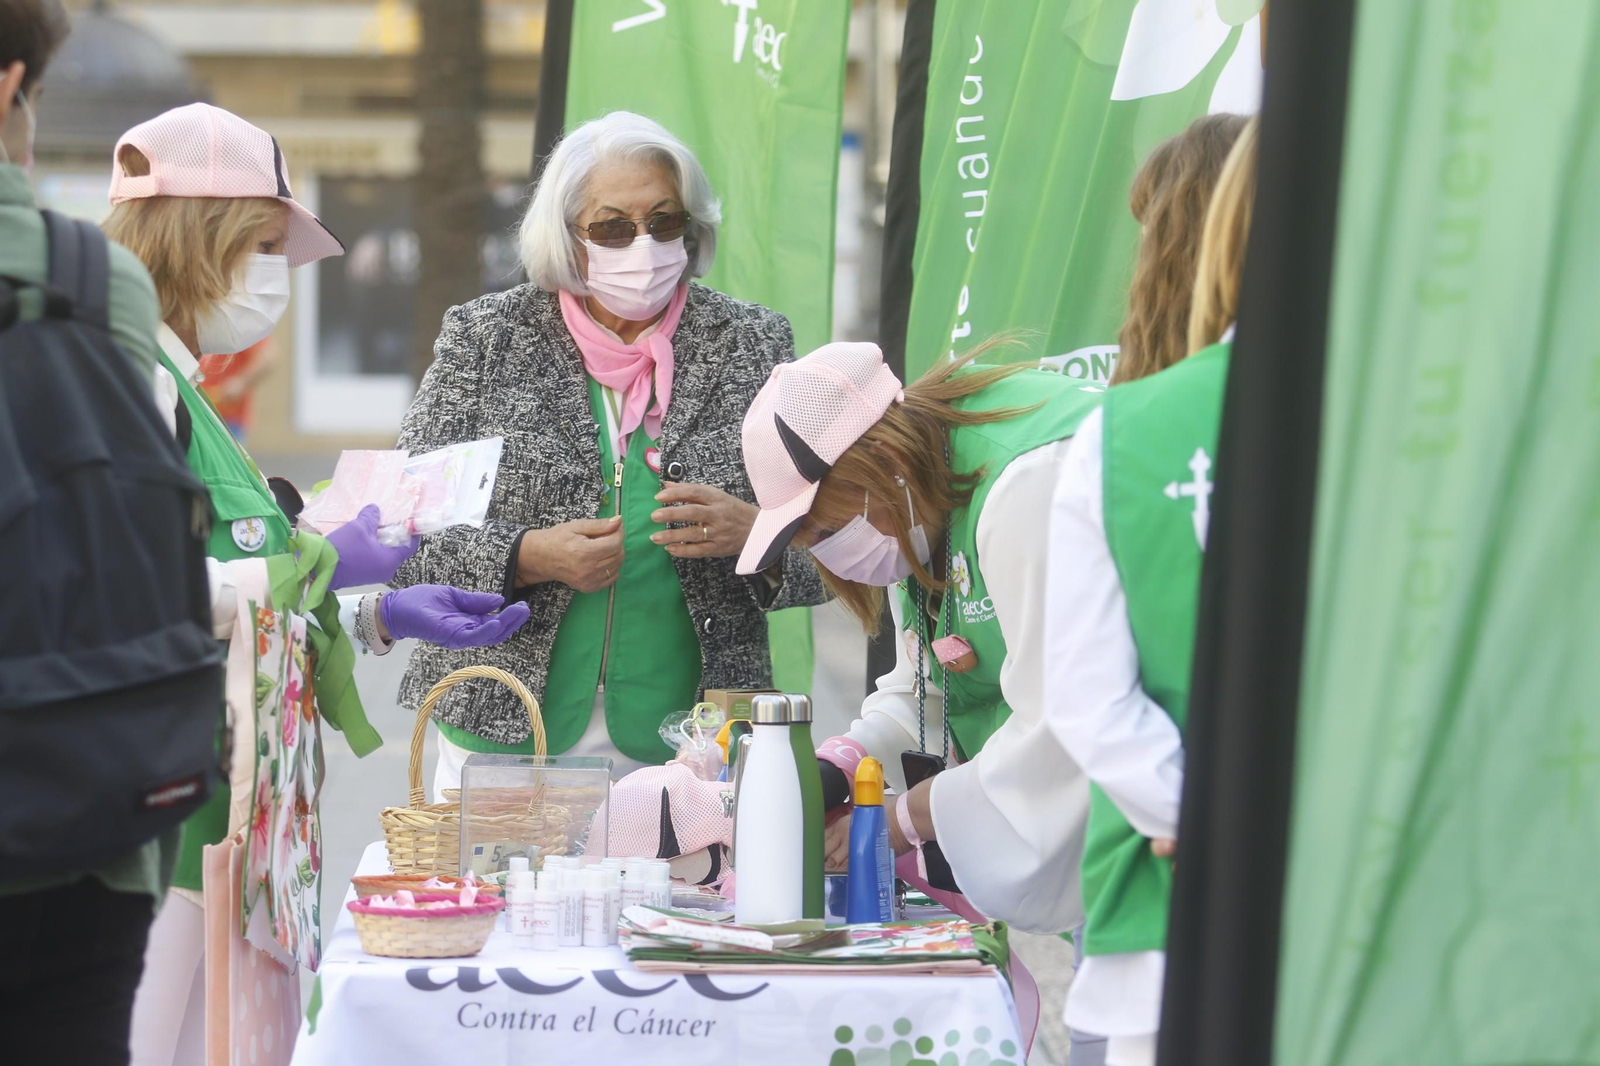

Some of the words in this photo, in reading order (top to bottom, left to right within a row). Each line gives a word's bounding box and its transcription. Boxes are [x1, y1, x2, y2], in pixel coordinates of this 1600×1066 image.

[1396, 362, 1464, 460] tu
[491, 845, 502, 863] 5
[457, 1001, 556, 1031] Contra
[573, 1006, 597, 1033] el
[613, 1007, 717, 1038] Cáncer
